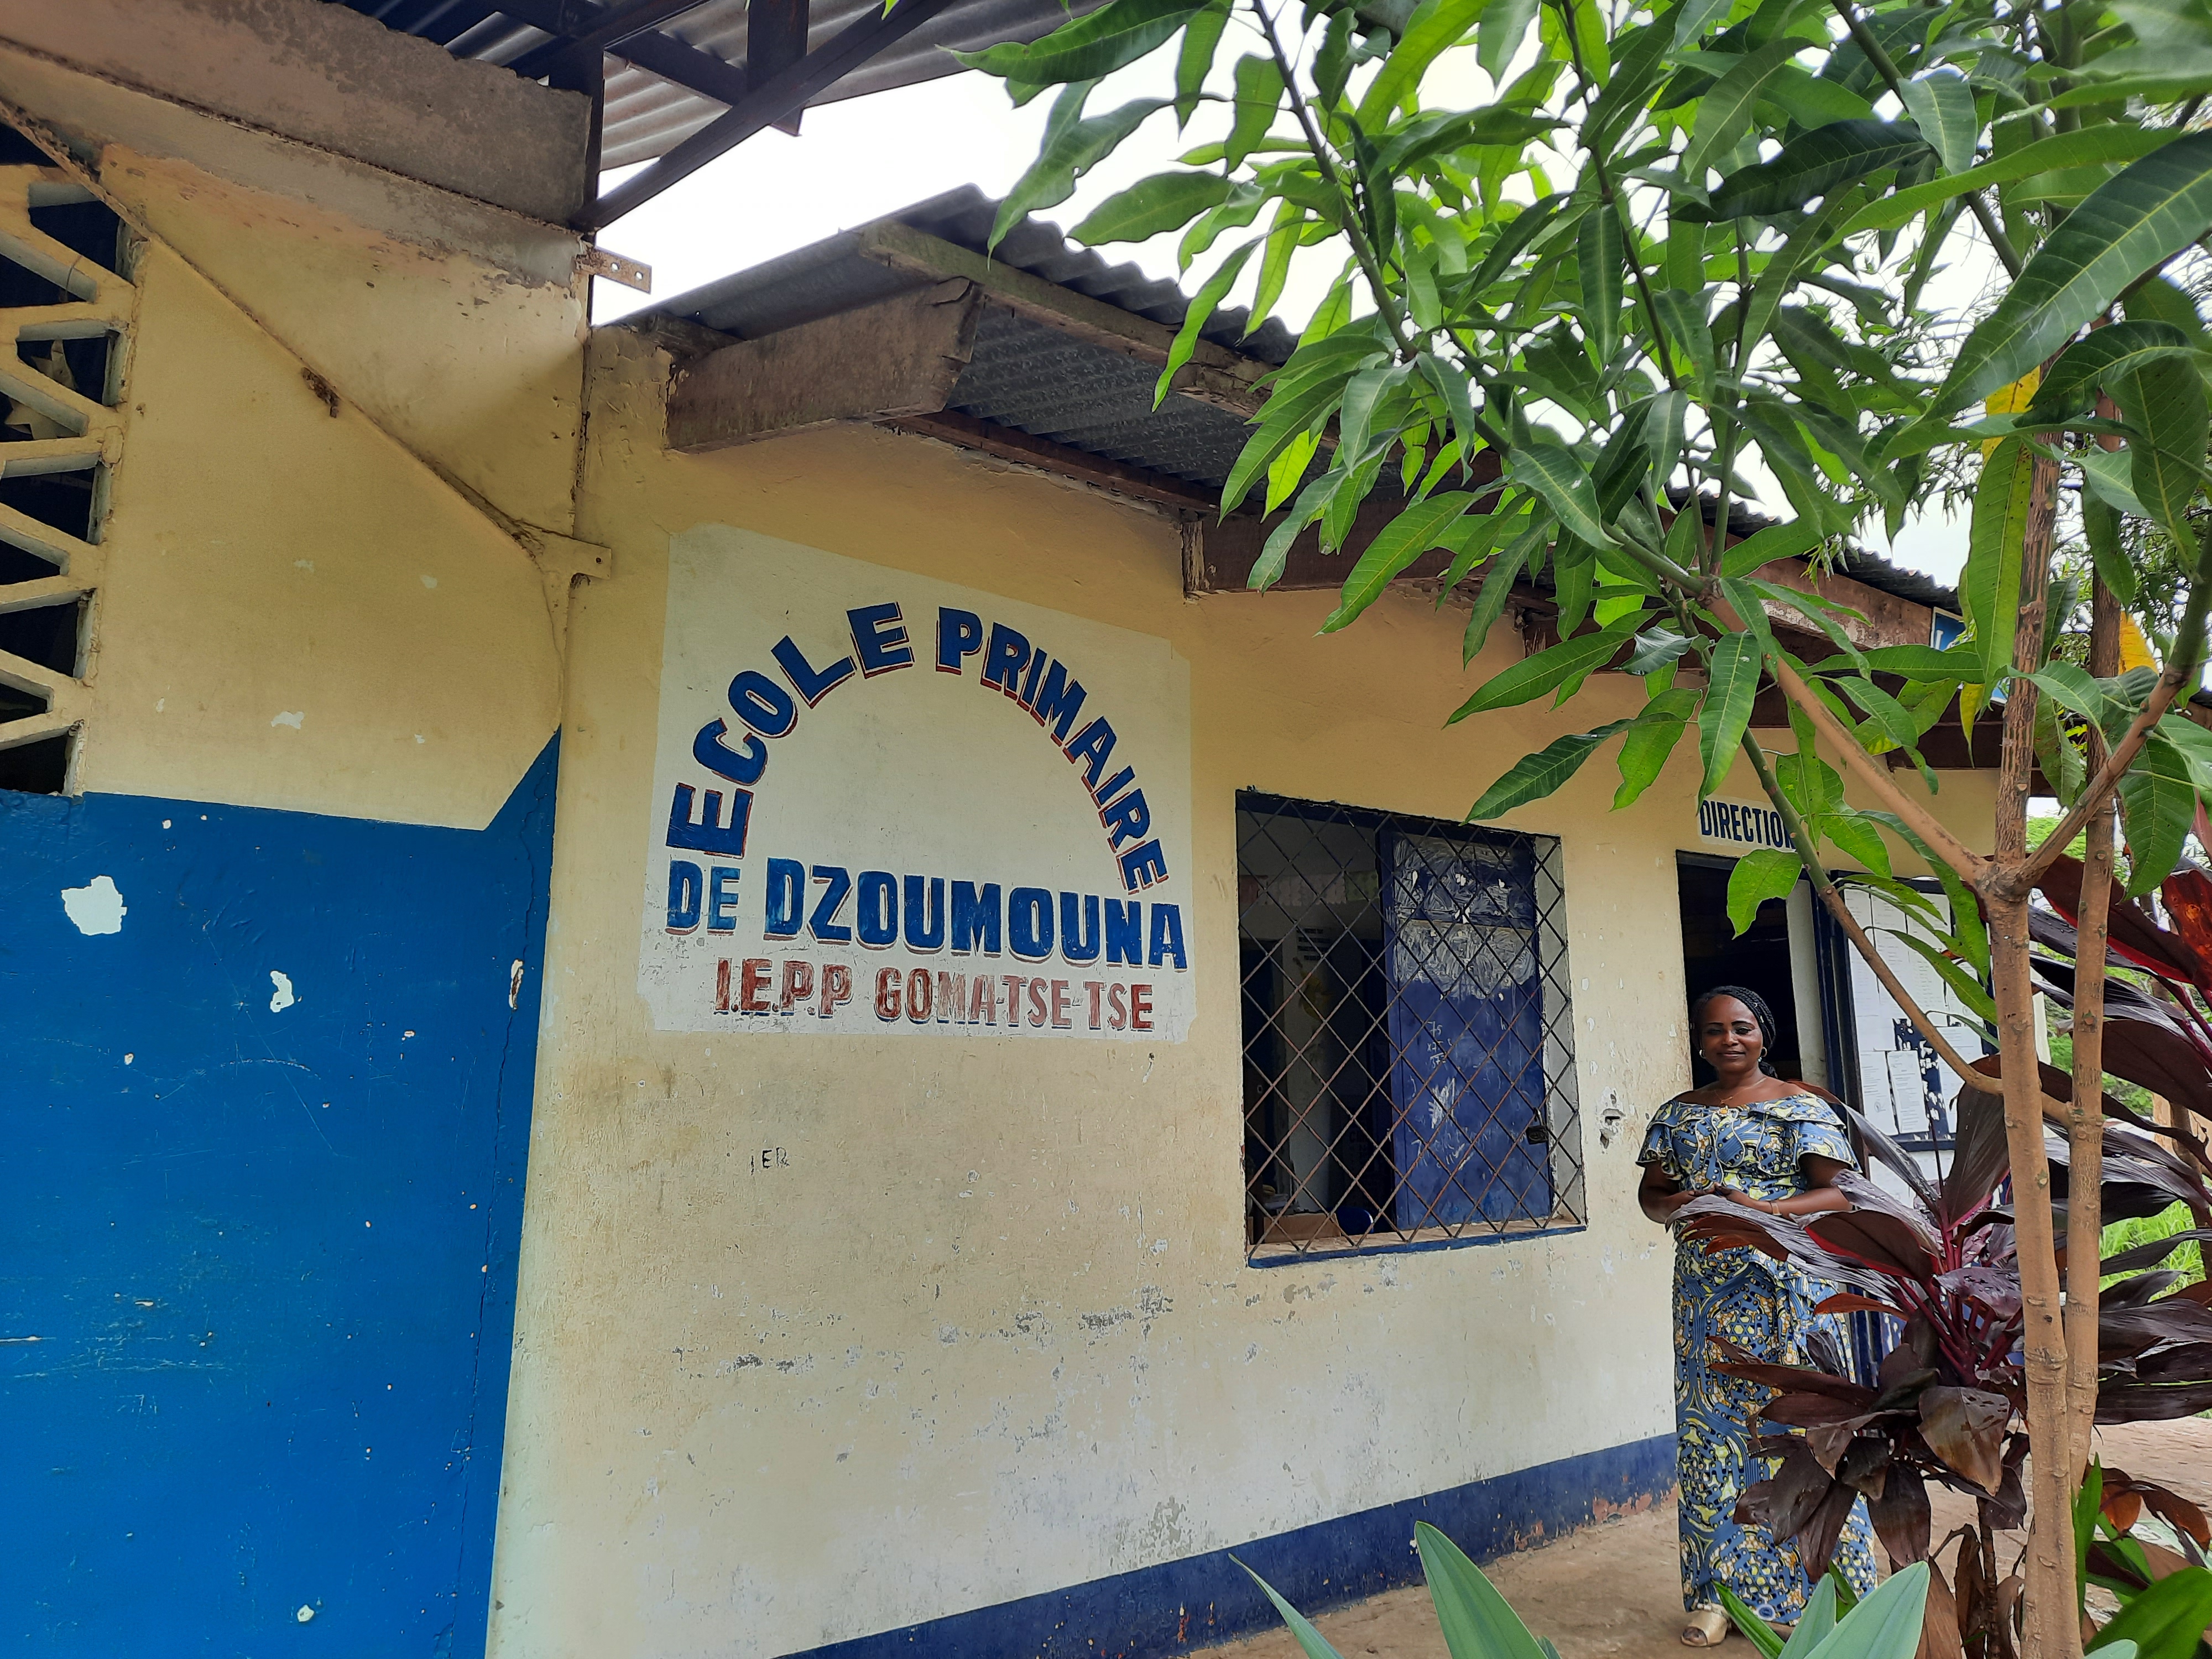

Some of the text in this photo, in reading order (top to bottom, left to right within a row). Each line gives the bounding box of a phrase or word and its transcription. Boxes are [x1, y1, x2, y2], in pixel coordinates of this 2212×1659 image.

[665, 602, 1169, 895] ECOLE PRIMAIRE
[665, 857, 1188, 973] DE DZOUMOUNA
